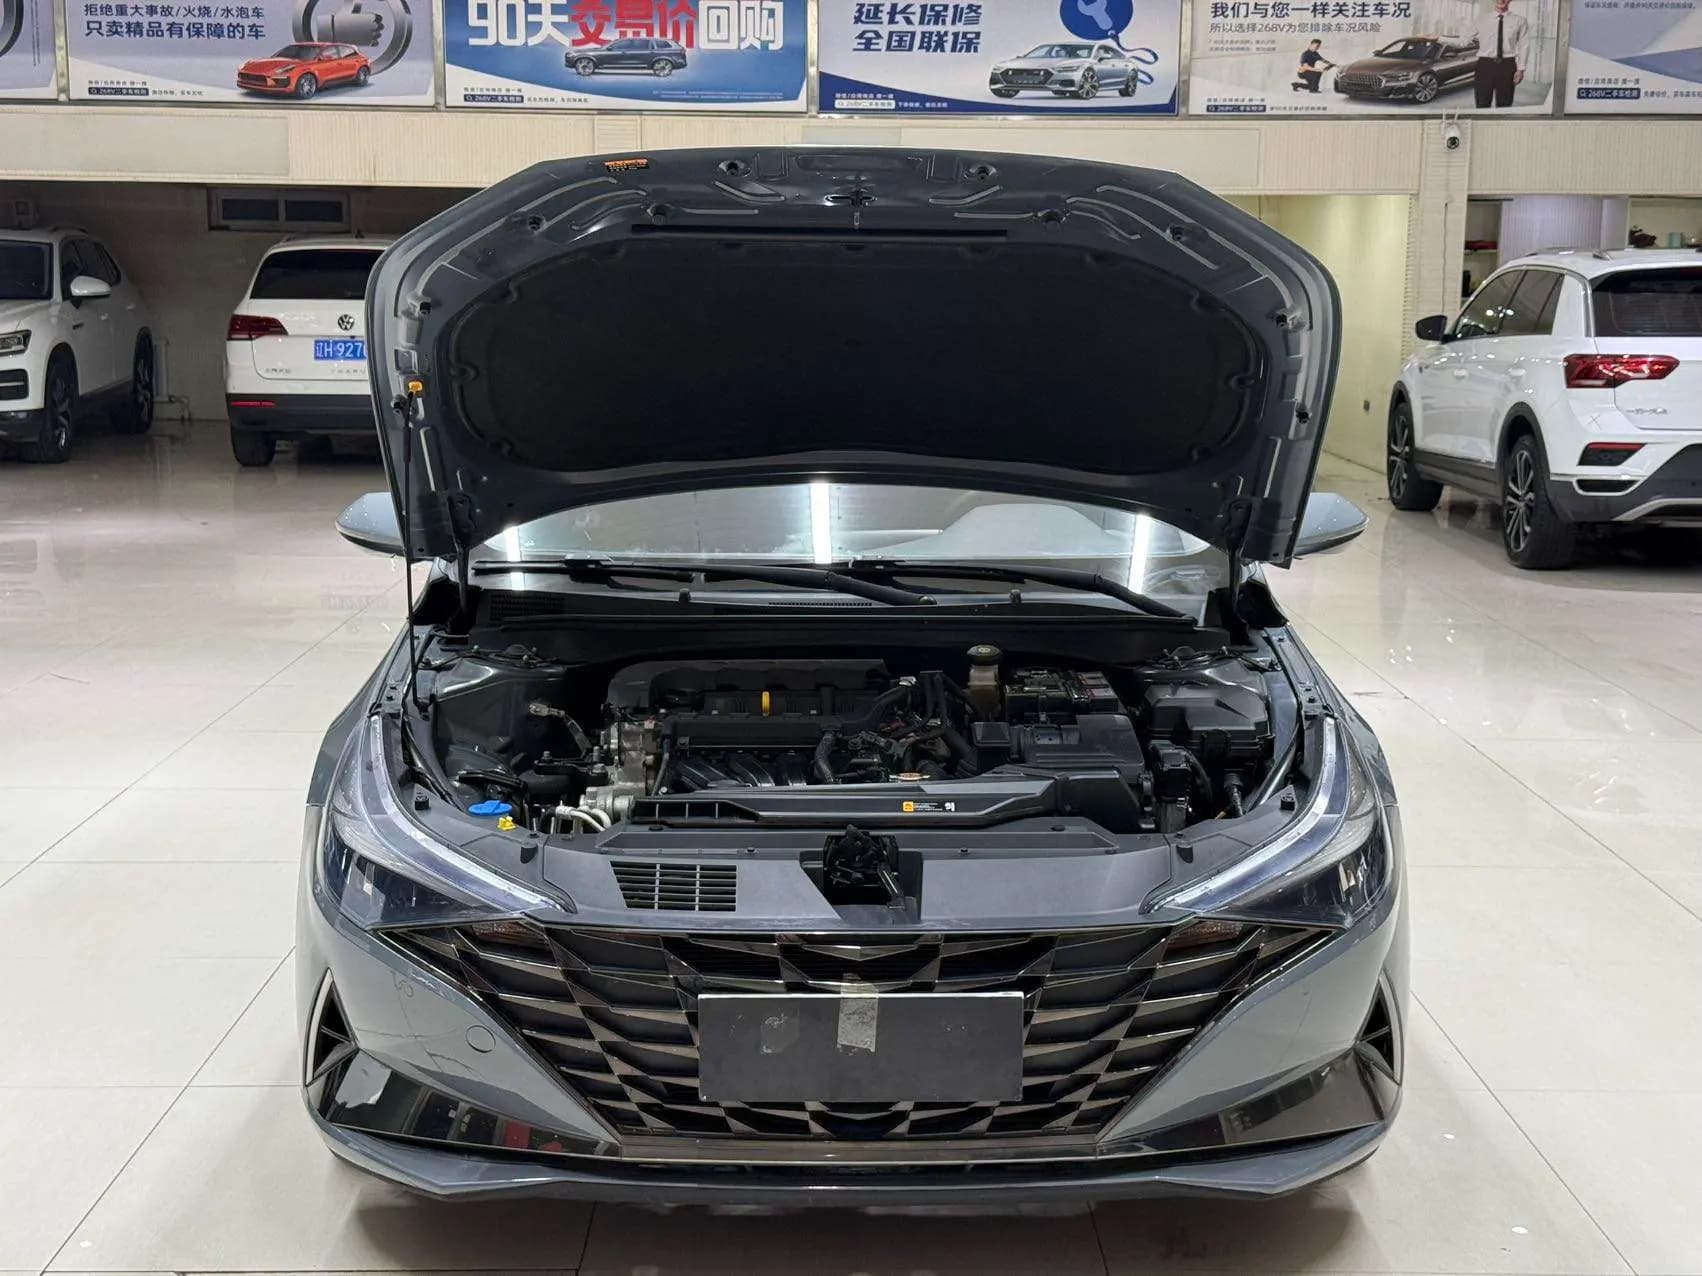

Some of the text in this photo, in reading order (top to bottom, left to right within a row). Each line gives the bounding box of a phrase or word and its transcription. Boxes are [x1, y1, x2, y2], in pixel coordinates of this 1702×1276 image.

[84, 4, 265, 19] 拒绝重大事故/火烧/水泡车
[853, 3, 983, 26] 延长保修
[1210, 2, 1412, 18] 我们与您一样关注车况
[85, 20, 266, 40] 只卖精品有保障的车
[468, 0, 784, 50] 90天交易价回购
[1209, 22, 1382, 34] 所以选择268V为您排除车况风险
[852, 30, 982, 53] 全国联保
